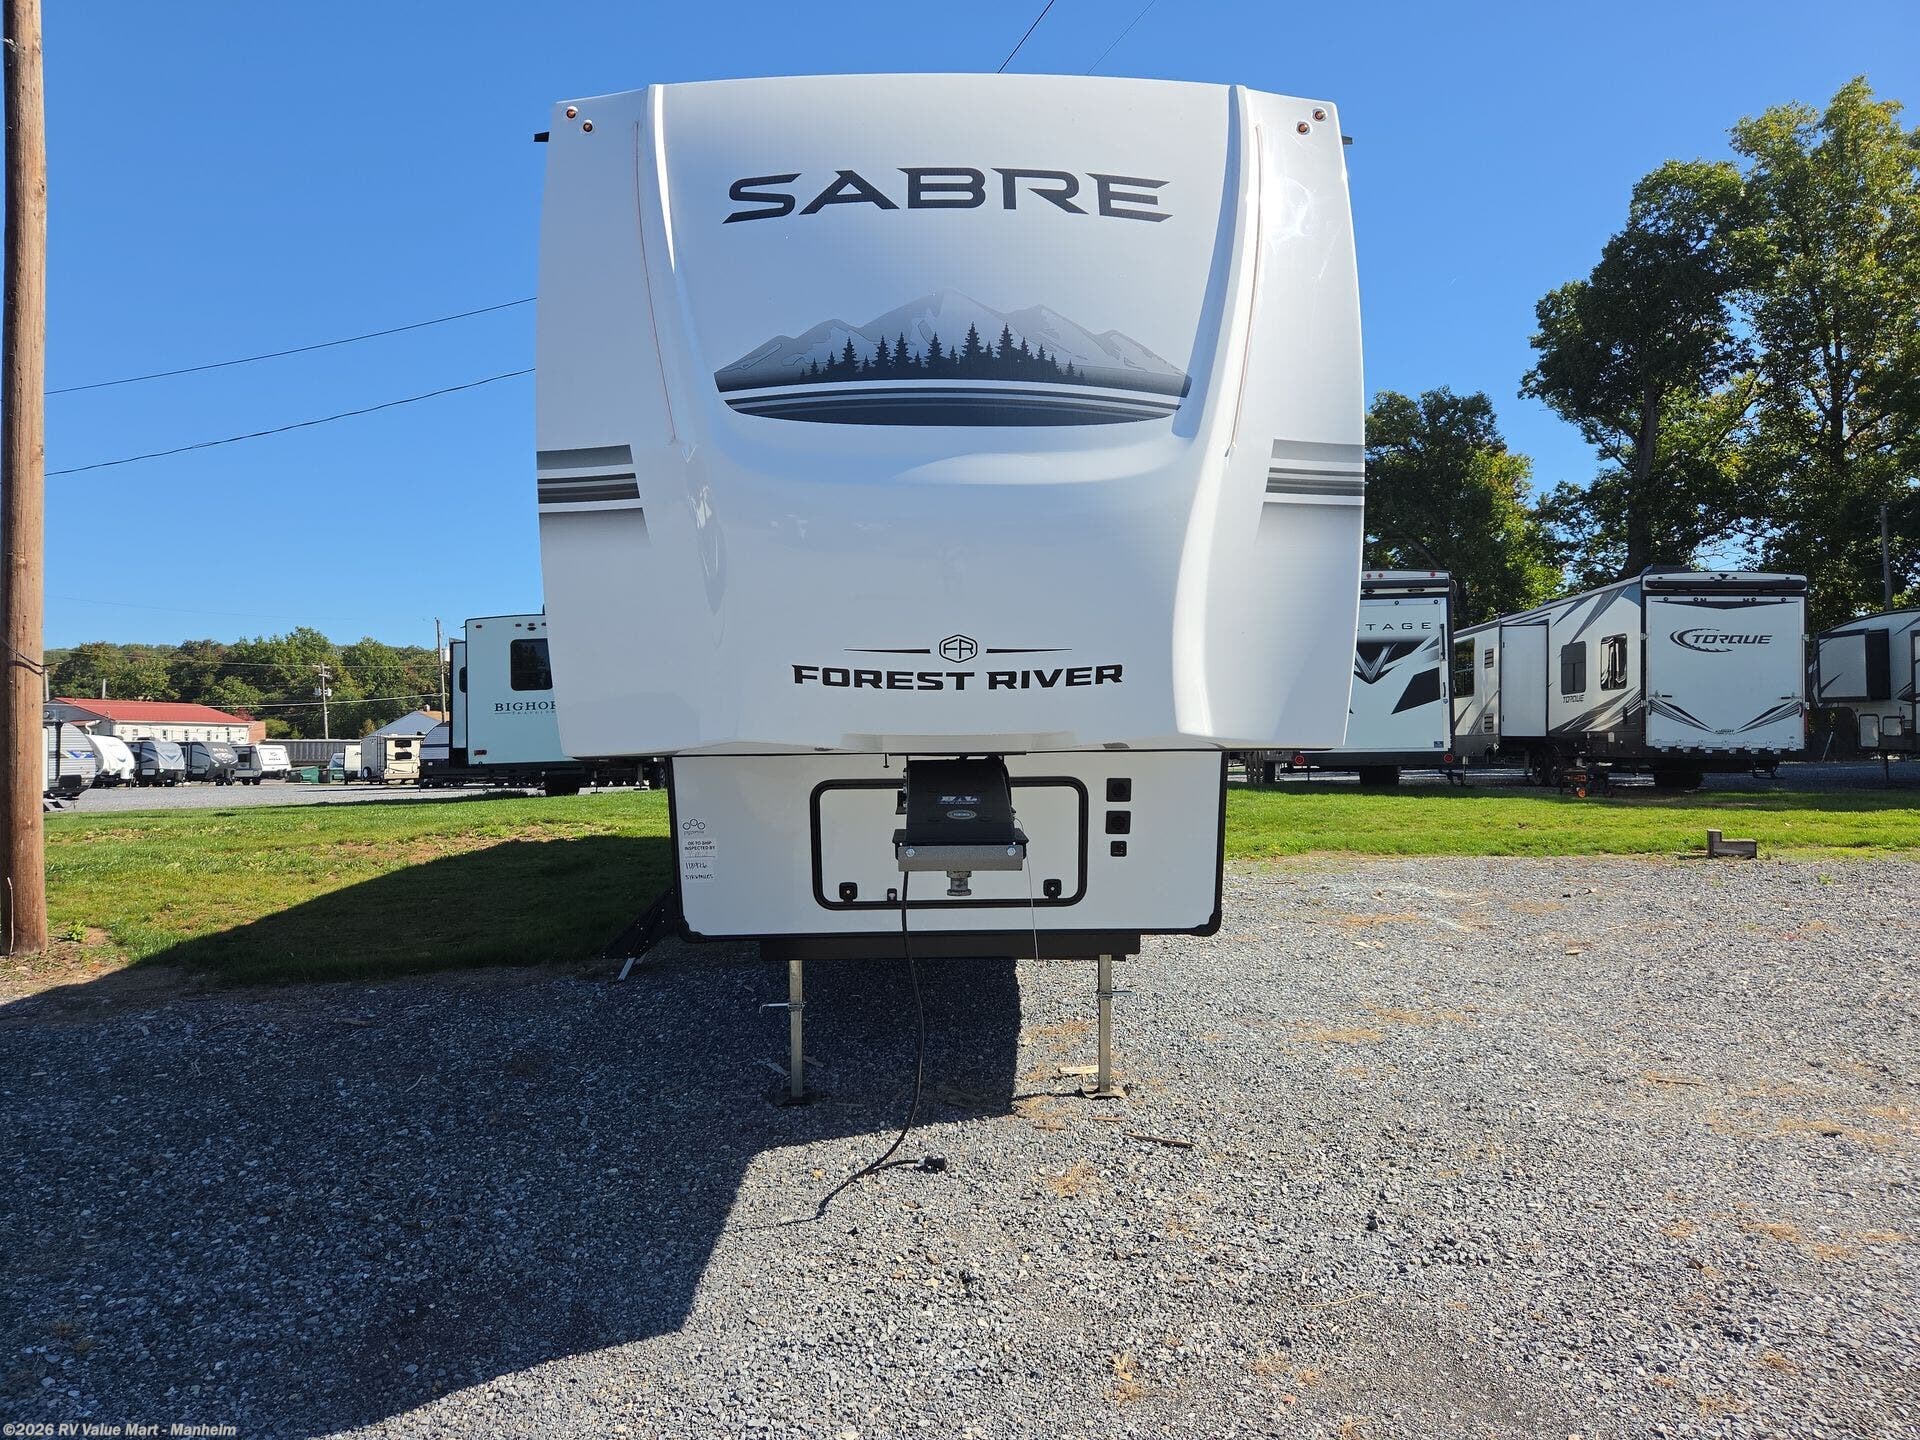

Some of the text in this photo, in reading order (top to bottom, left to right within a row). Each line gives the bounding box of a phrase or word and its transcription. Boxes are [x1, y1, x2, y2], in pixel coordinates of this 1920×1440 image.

[722, 167, 1174, 224] SABRE
[1357, 622, 1432, 631] TAGE
[1692, 634, 1773, 644] TORQUE
[791, 664, 1123, 691] FOREST RIVER
